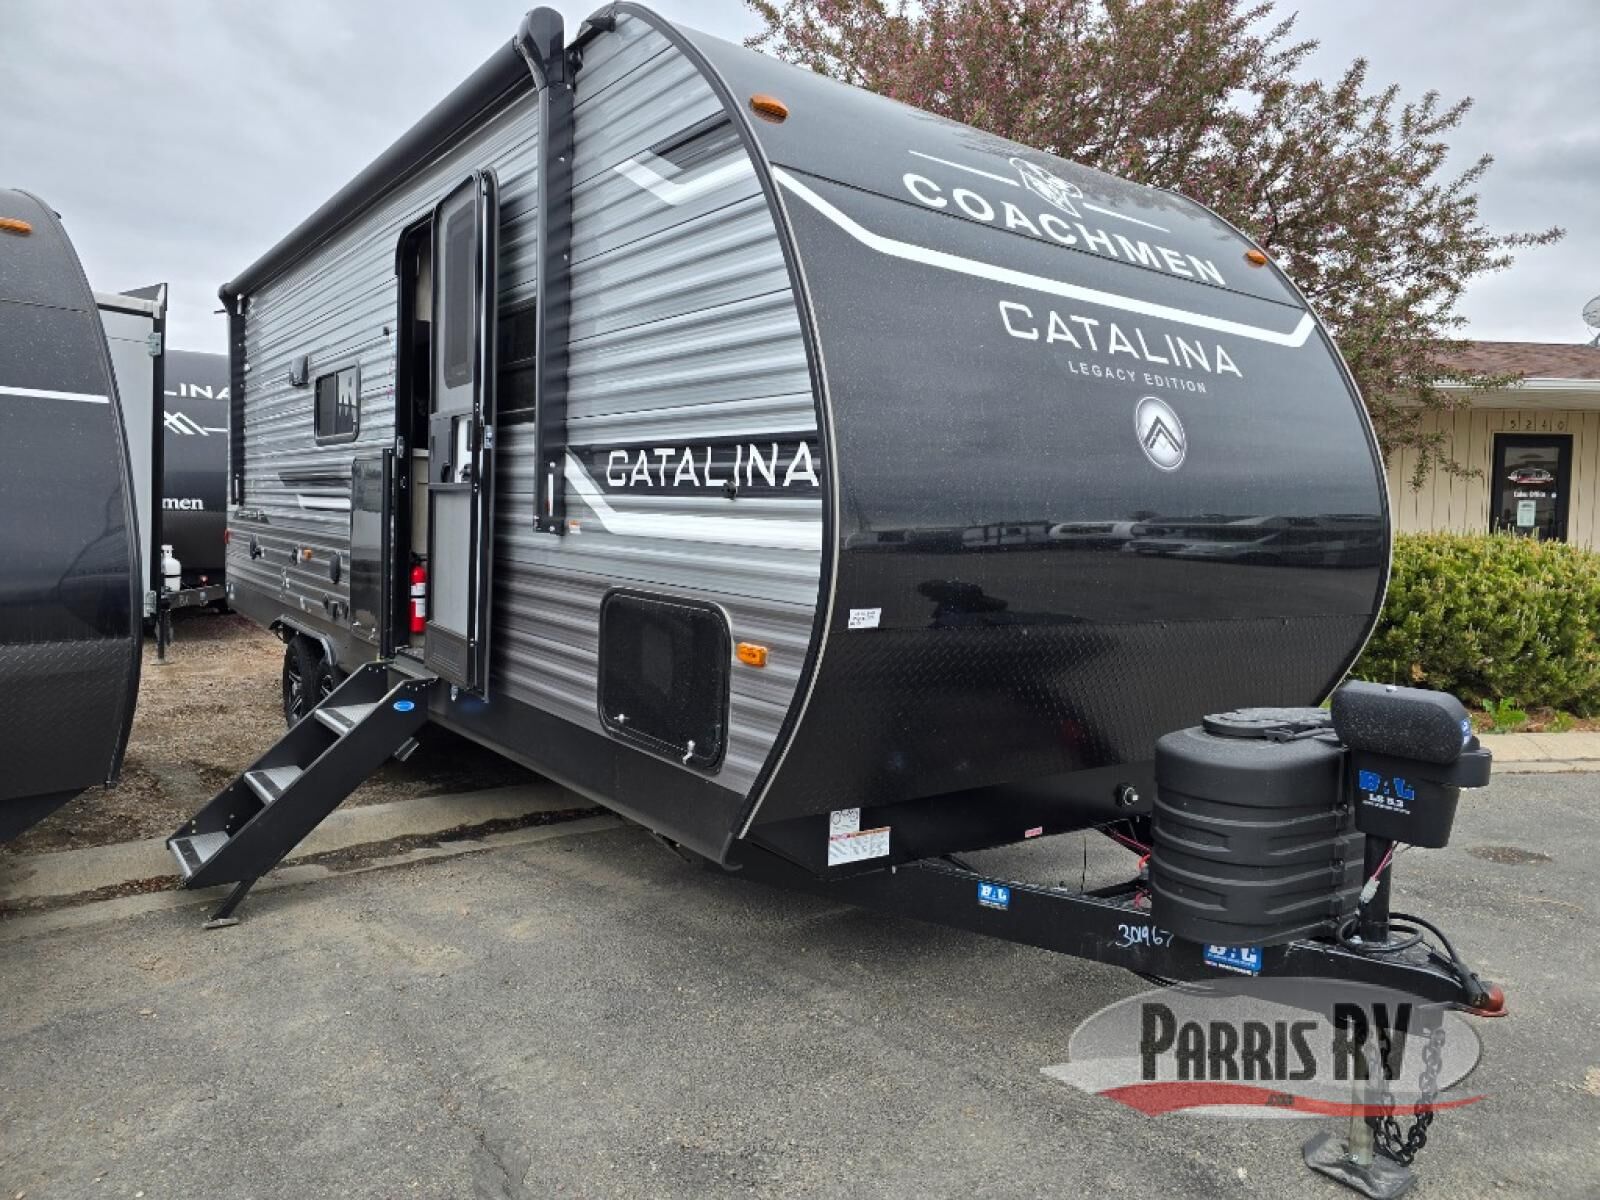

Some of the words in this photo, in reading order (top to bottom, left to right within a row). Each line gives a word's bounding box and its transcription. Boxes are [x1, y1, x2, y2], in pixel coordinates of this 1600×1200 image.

[903, 173, 1226, 285] COACHMEN
[999, 300, 1243, 379] CATALINA
[1068, 360, 1135, 382] LEGACY
[1144, 373, 1206, 393] EDITION
[605, 441, 820, 487] CATALINA
